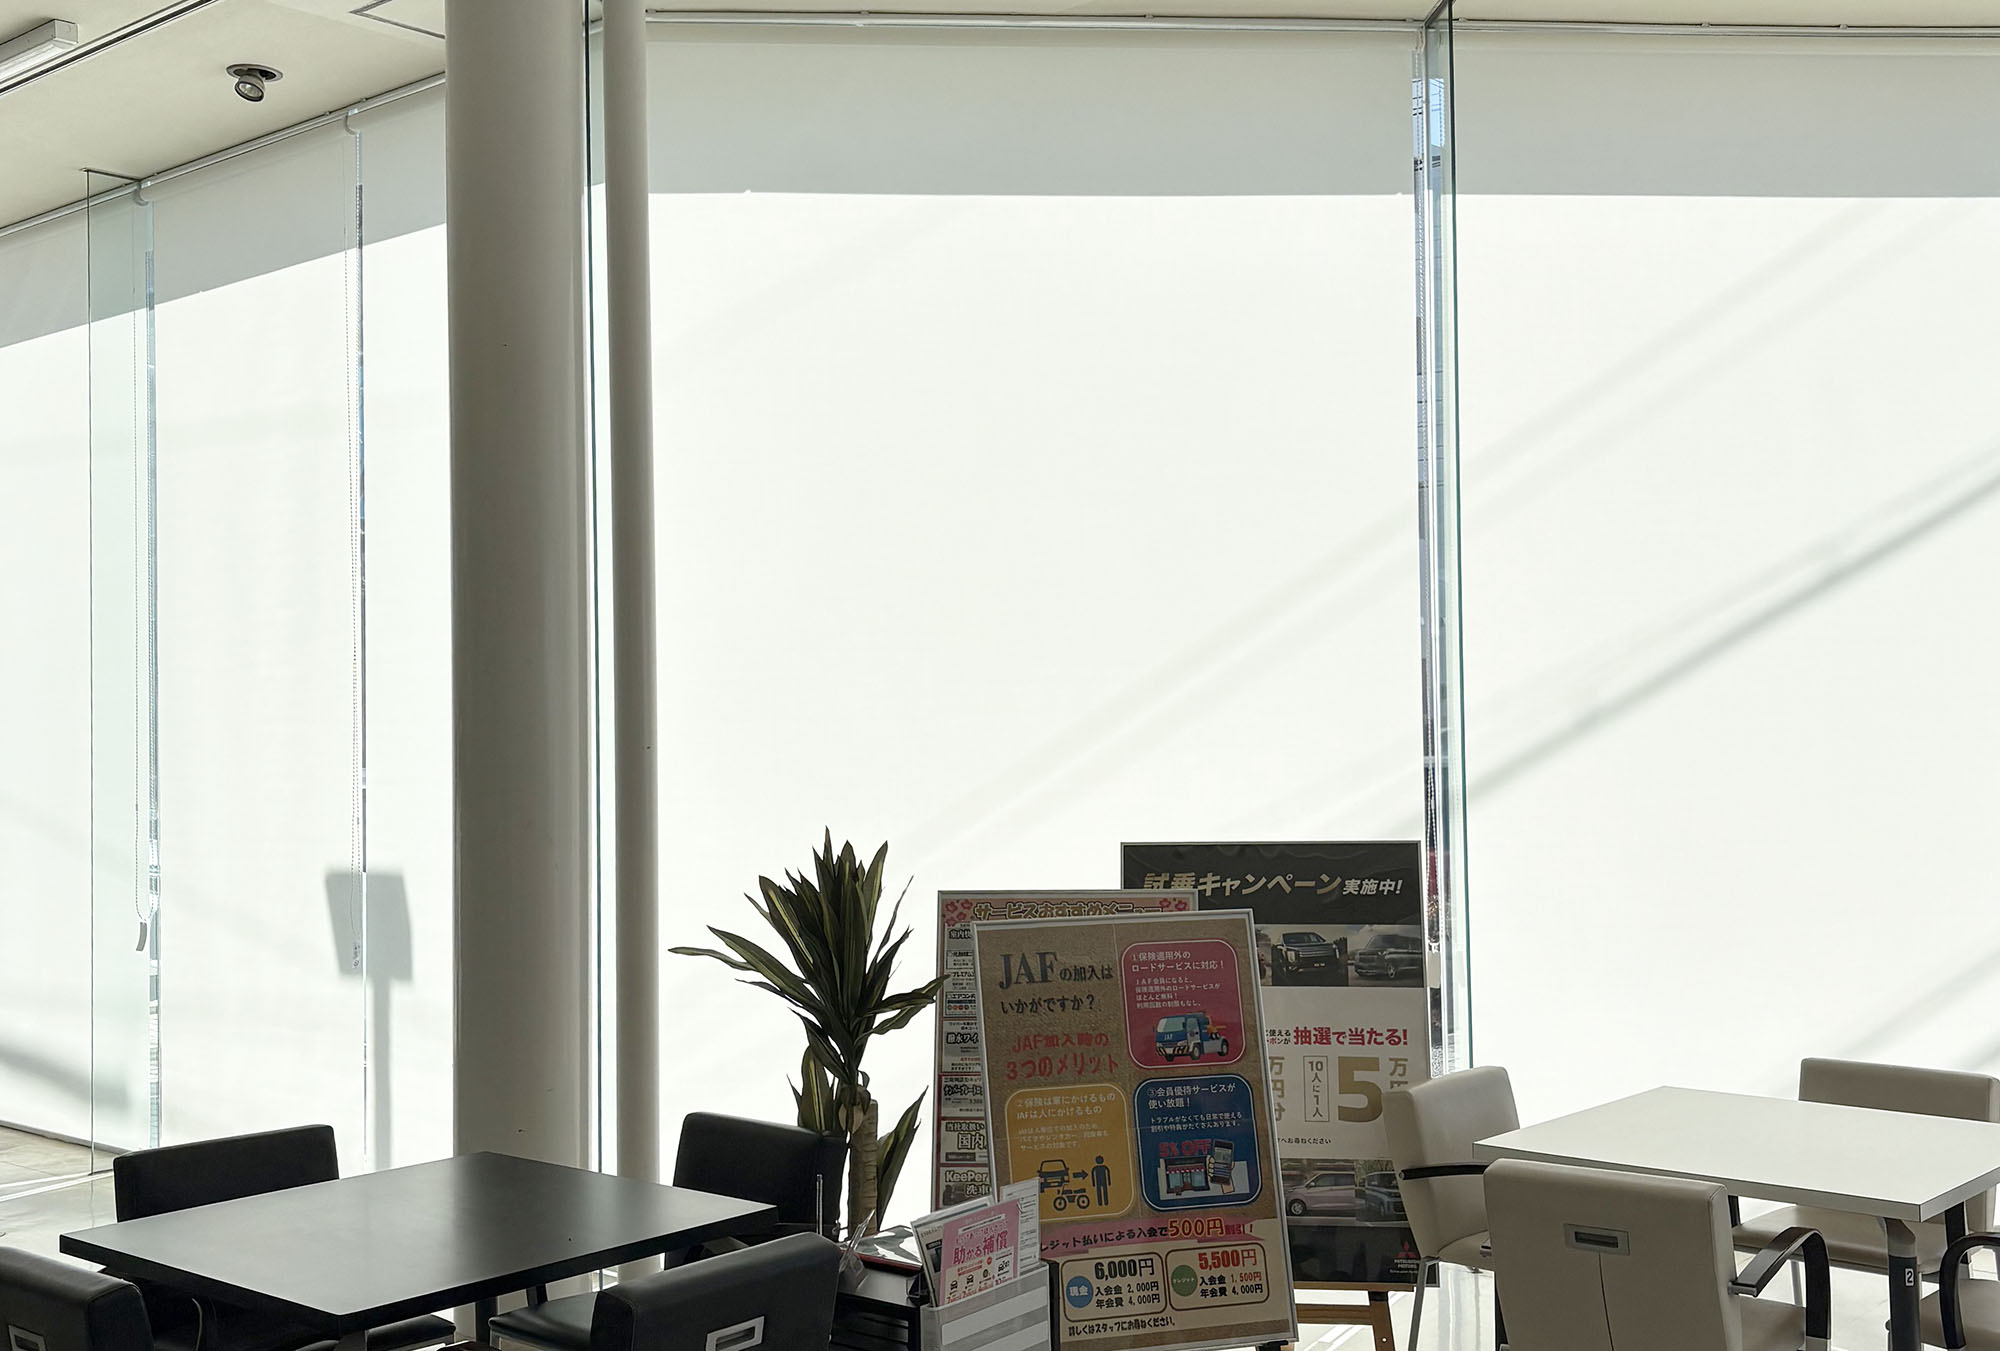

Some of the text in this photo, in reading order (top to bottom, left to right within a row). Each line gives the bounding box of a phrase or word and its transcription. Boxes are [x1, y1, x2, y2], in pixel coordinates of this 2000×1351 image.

[1131, 960, 1224, 973] ロードサービスに対応！
[1001, 994, 1096, 1015] いかがですか？
[1293, 1026, 1408, 1046] 抽選で当たる!
[1005, 1052, 1119, 1080] 3つのメリット
[1148, 1097, 1191, 1109] 使い放題！
[1278, 1136, 1332, 1145] へお尋ねください
[1198, 1247, 1258, 1271] 5,500円
[1094, 1257, 1155, 1282] 6,000円
[1199, 1275, 1227, 1287] 入会金
[1069, 1285, 1089, 1297] 現金
[1095, 1286, 1122, 1297] 入会金
[1200, 1284, 1263, 1299] 年会費 4,000円
[1096, 1297, 1124, 1309] 年会費
